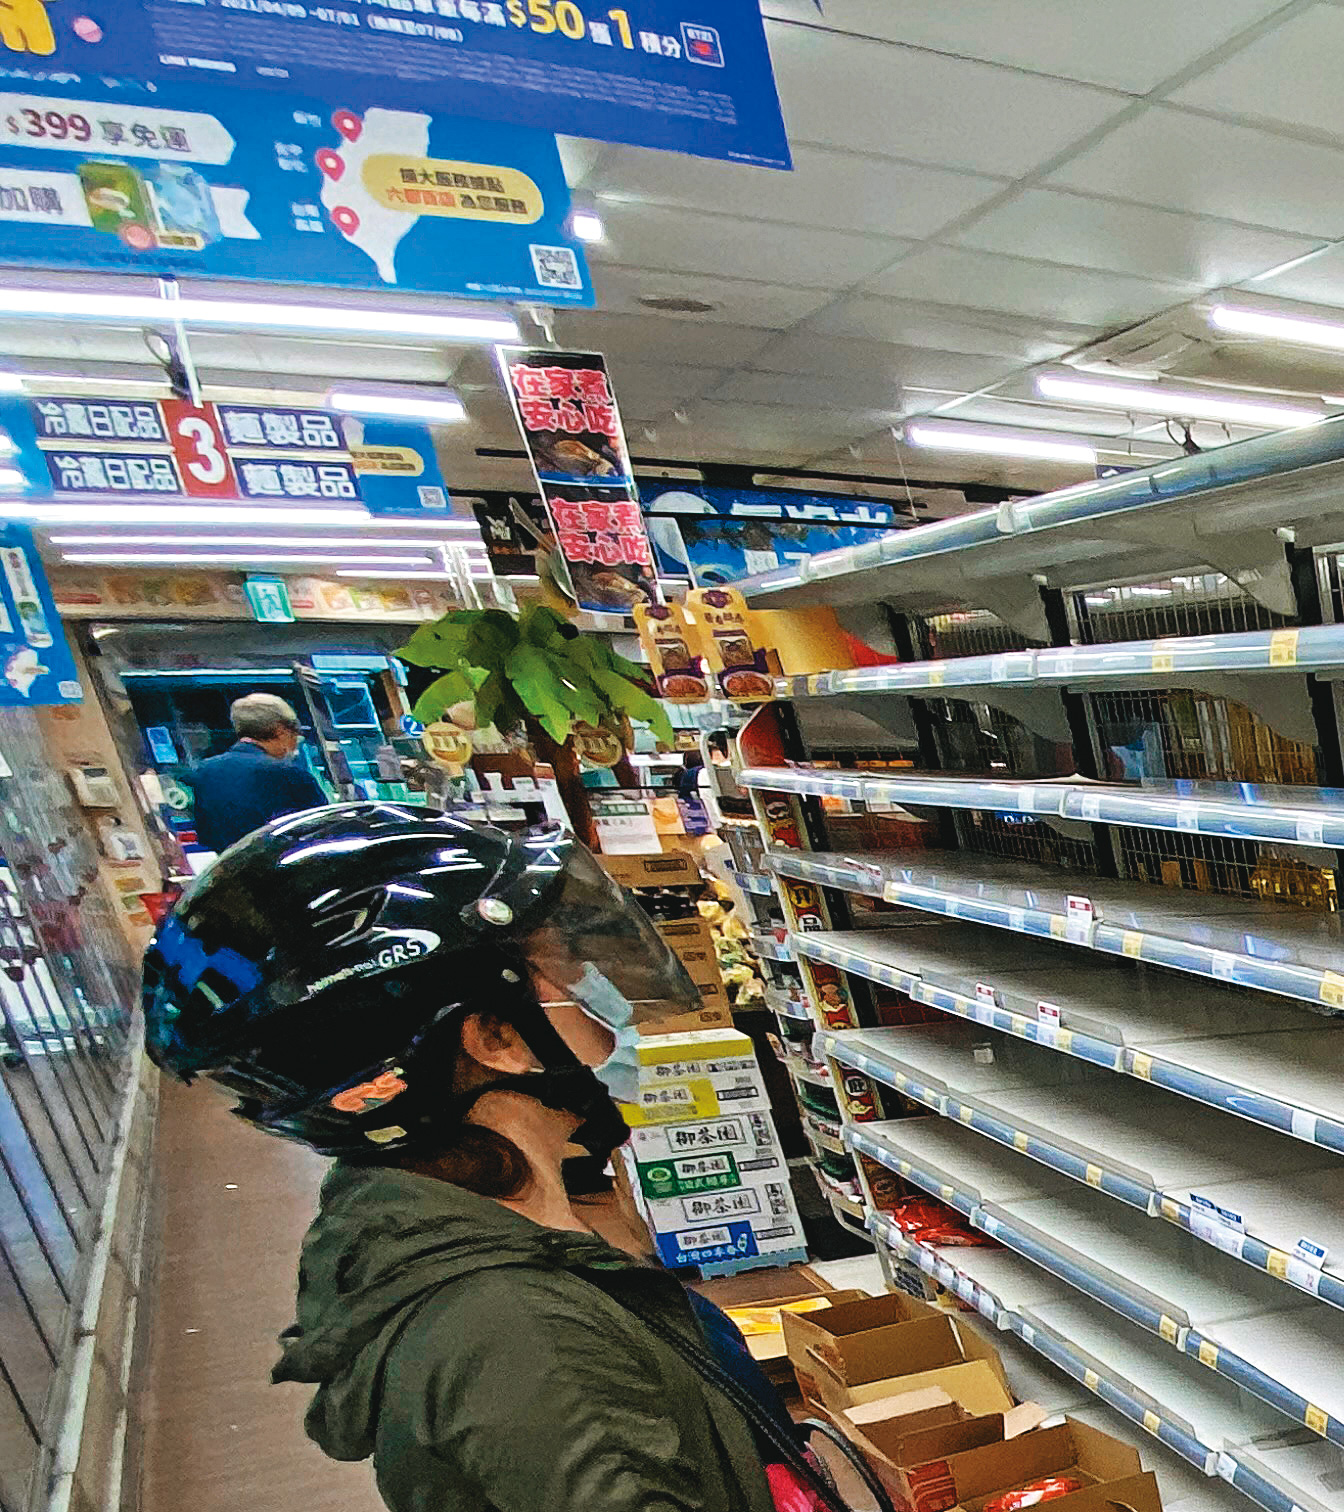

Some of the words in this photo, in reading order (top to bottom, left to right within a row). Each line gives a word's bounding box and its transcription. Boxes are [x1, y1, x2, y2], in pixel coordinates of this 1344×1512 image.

[6, 108, 92, 142] $399
[178, 417, 227, 484] 3
[379, 939, 421, 968] GRS
